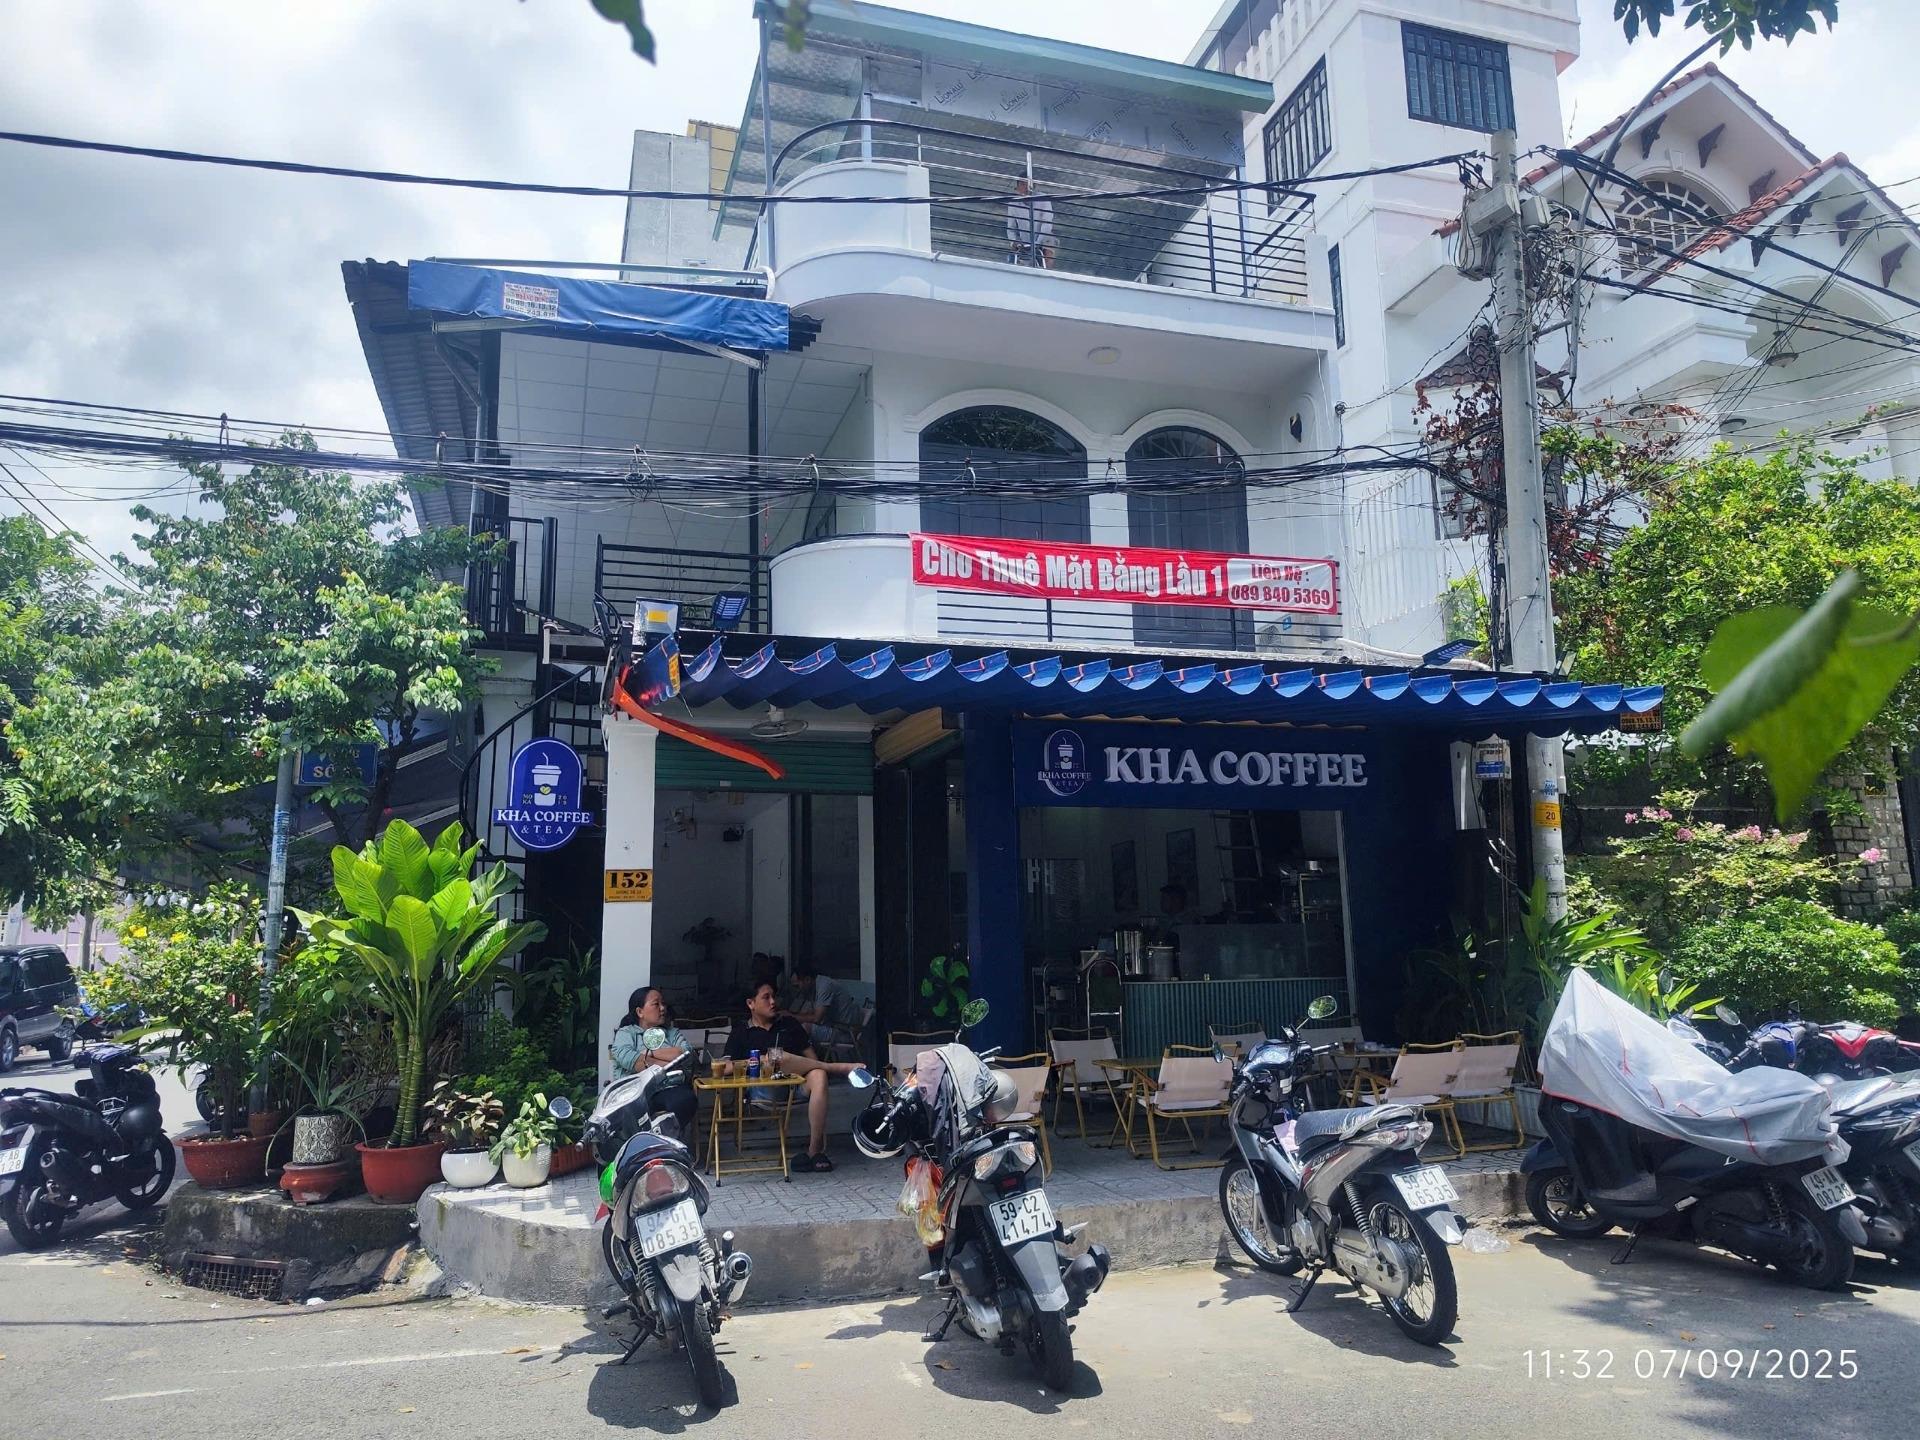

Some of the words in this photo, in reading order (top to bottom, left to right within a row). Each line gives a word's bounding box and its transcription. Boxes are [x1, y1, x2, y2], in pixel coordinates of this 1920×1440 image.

[922, 540, 972, 579] Cho
[975, 550, 1041, 587] Thuê
[1045, 554, 1093, 595] Mặt
[1097, 552, 1160, 597] Bằng
[1165, 555, 1207, 597] Lầu
[1210, 566, 1223, 597] 1
[1251, 563, 1281, 580] Liên
[1231, 584, 1259, 601] 089
[1263, 586, 1290, 602] 840
[1293, 587, 1330, 606] 5369
[1042, 771, 1060, 779] KHA
[1104, 747, 1208, 784] KHA
[1209, 750, 1368, 787] COFFEE
[497, 809, 531, 821] KHA
[534, 810, 590, 823] COFFEE
[1545, 811, 1555, 820] 20
[521, 825, 530, 834] &
[609, 871, 648, 888] 152
[1000, 1195, 1041, 1221] 59-C2
[1002, 1212, 1051, 1241] 414.74
[645, 1221, 699, 1253] 085.35
